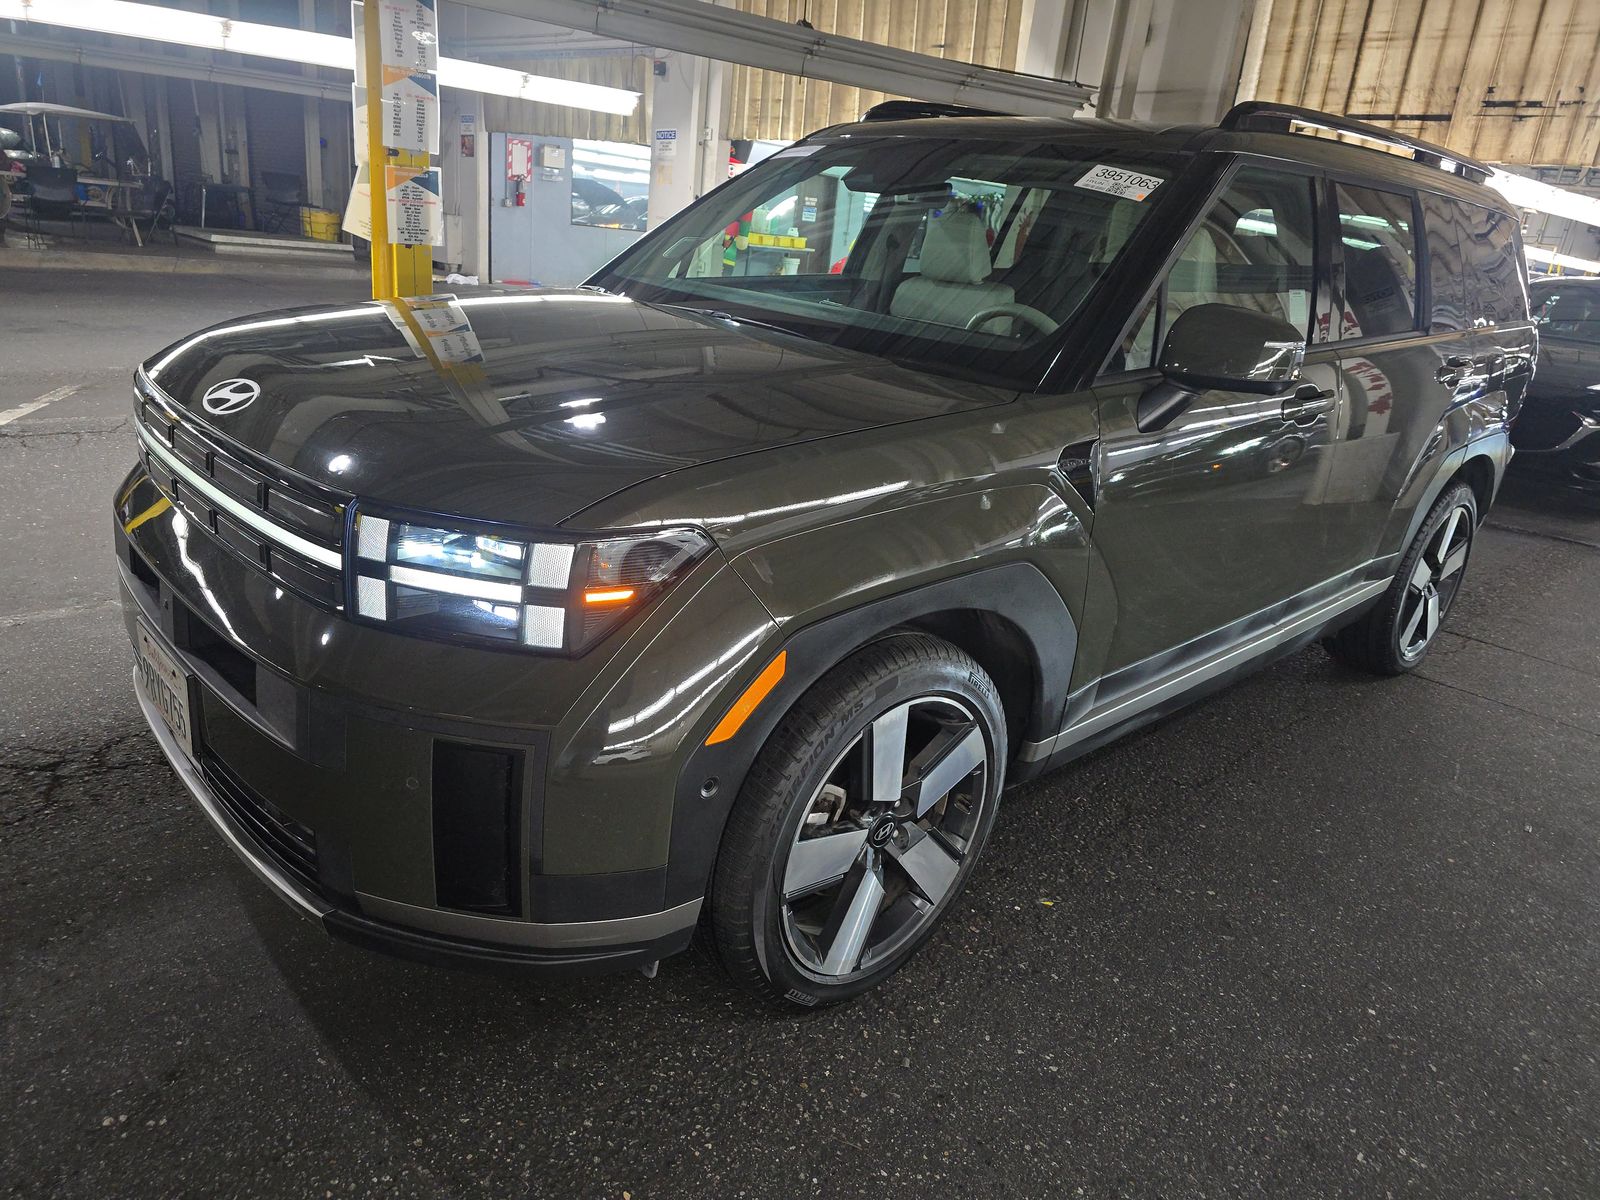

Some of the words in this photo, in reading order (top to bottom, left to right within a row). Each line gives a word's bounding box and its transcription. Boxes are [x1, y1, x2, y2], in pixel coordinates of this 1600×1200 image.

[657, 131, 676, 139] NOTICE
[1096, 168, 1160, 190] 3951063
[968, 670, 991, 699] PIRELLI
[783, 988, 819, 1006] PIRELLI
